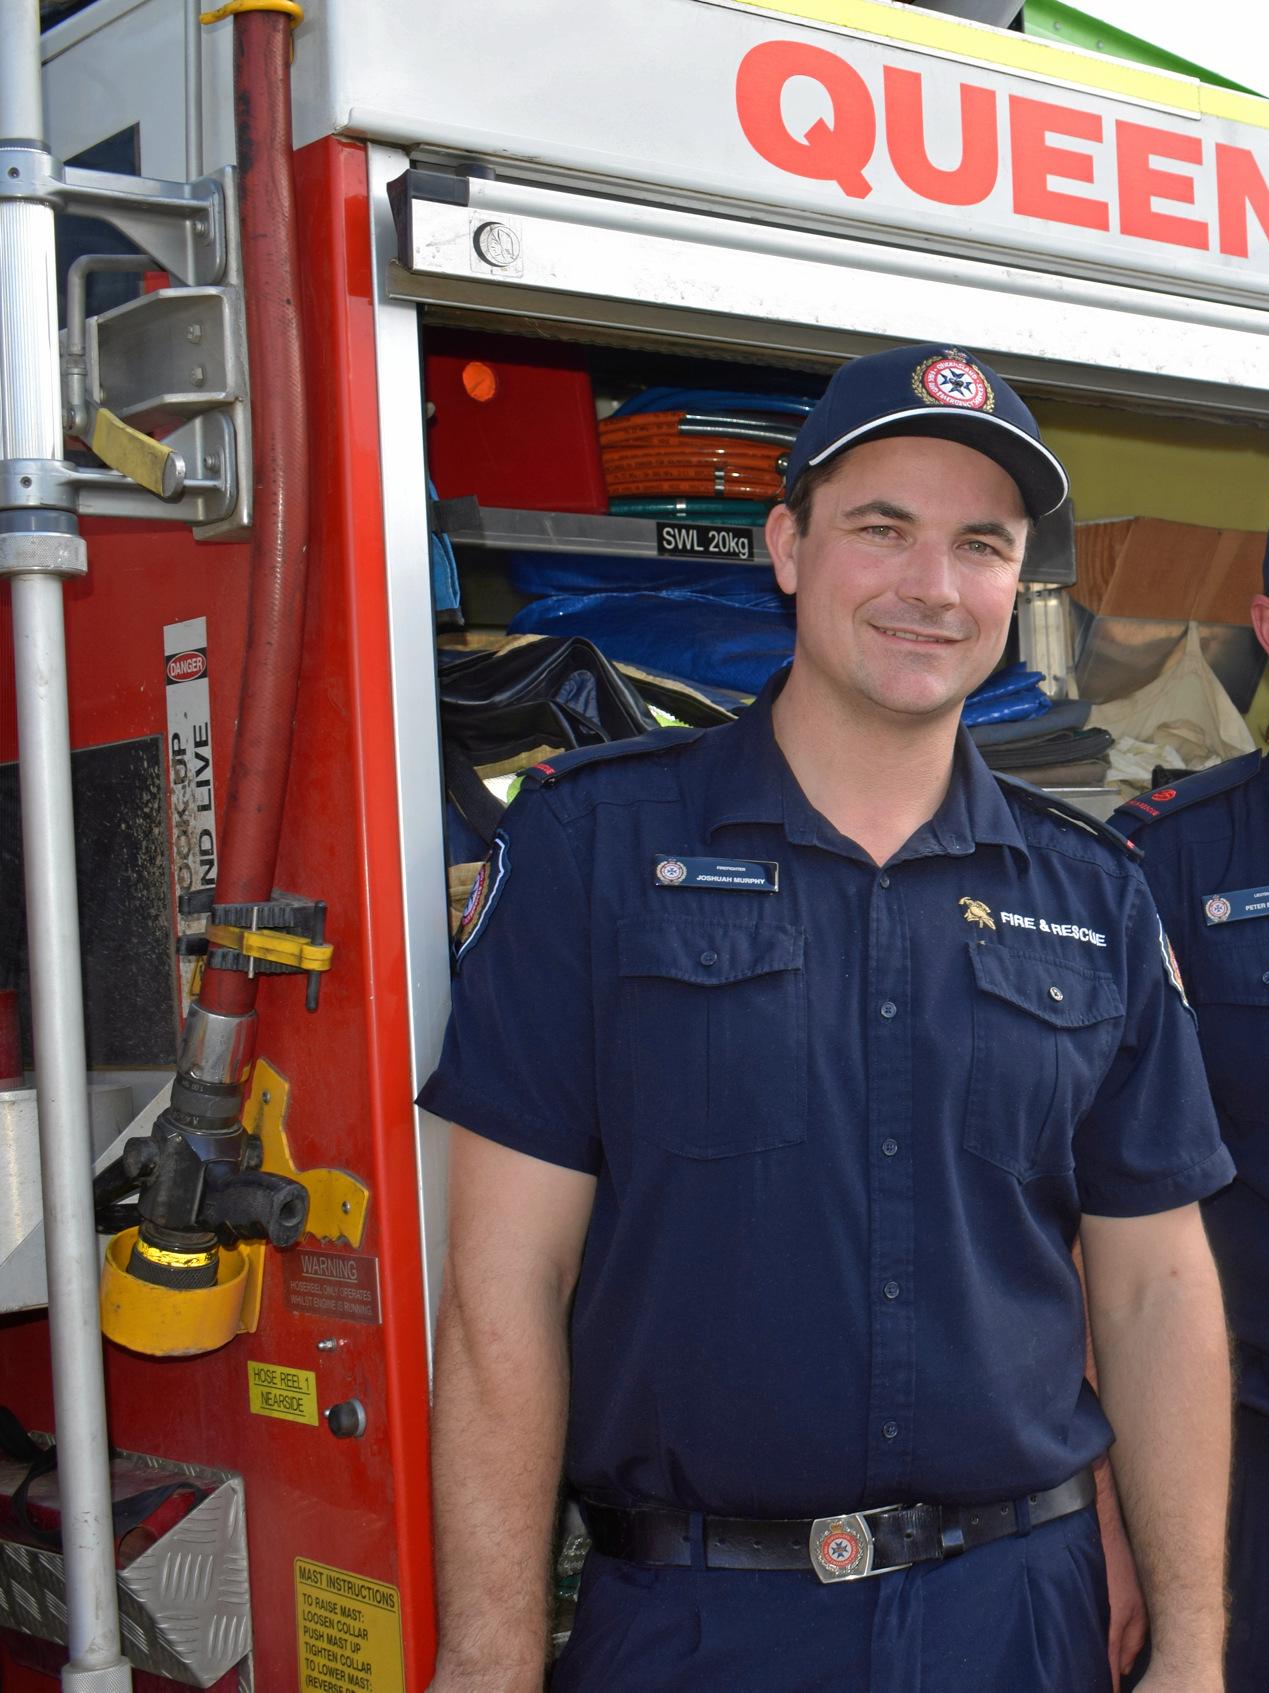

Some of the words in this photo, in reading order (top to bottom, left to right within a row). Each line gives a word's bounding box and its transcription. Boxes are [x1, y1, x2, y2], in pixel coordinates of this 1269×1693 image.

[662, 527, 704, 551] SWL
[708, 531, 749, 559] 20kg
[169, 657, 203, 677] DANGER
[193, 722, 212, 812] LIVE
[198, 828, 216, 886] ND
[696, 874, 733, 883] JOSHUAH
[733, 876, 766, 885] MURPHY
[1245, 903, 1266, 911] PETER
[1001, 911, 1036, 930] FIRE
[1039, 918, 1051, 933] &
[1051, 923, 1107, 947] RESCUE
[301, 1255, 358, 1280] WARNING
[253, 1367, 278, 1386] HOSE
[280, 1371, 303, 1390] REEL
[304, 1376, 310, 1391] 1
[261, 1390, 304, 1413] NEARSIDE
[299, 1566, 324, 1584] MAST
[326, 1573, 396, 1609] INSTRUCTIONS
[302, 1593, 313, 1607] TO
[315, 1597, 338, 1615] RAISE
[339, 1605, 365, 1624] MAST:
[302, 1609, 335, 1631] LOOSEN
[336, 1620, 369, 1641] COLLAR
[303, 1626, 325, 1641] PUSH
[326, 1632, 348, 1651] MAST
[350, 1642, 362, 1655] UP
[304, 1641, 338, 1663] TIGHTEN
[339, 1653, 373, 1676] COLLAR
[305, 1657, 316, 1671] TO
[317, 1662, 346, 1681] LOWER
[347, 1671, 374, 1692] MAST:
